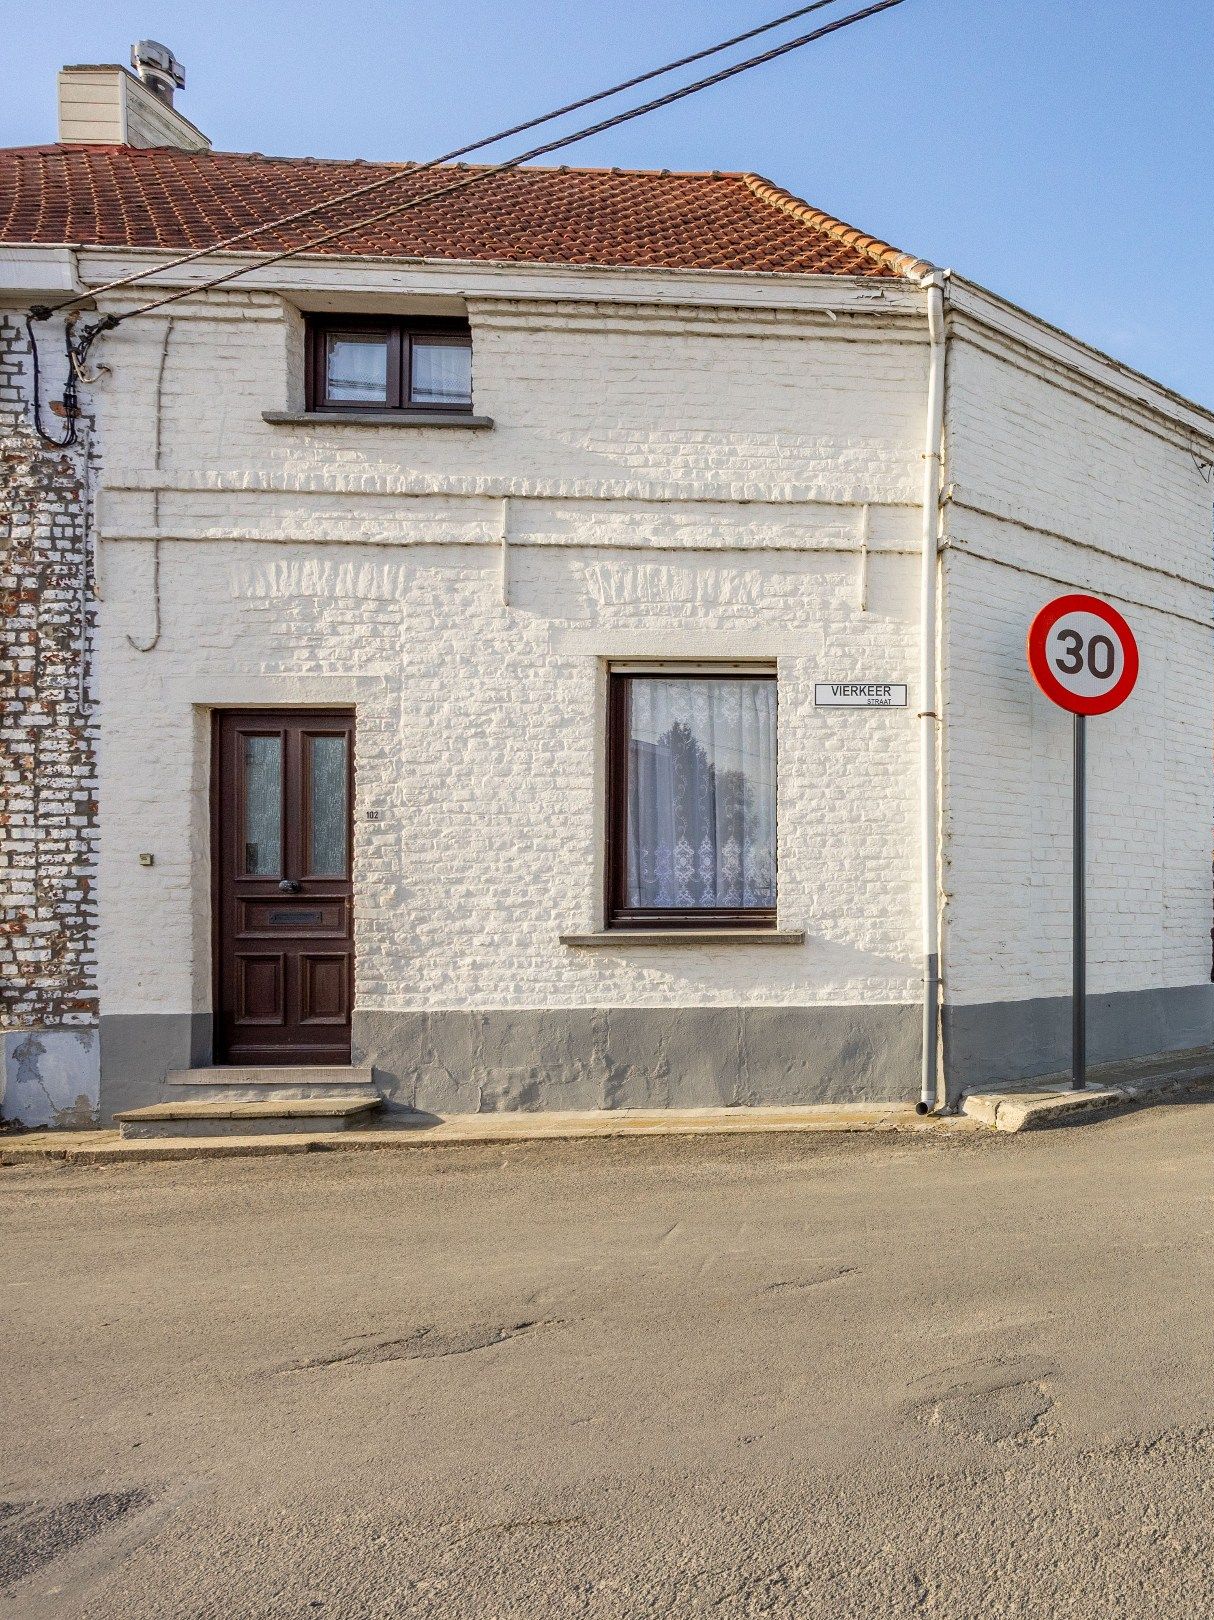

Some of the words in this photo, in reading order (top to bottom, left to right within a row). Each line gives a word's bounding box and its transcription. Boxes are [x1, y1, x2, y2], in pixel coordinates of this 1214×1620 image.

[1056, 629, 1114, 679] 30
[831, 686, 892, 696] VIERKEER
[366, 811, 378, 819] 102
